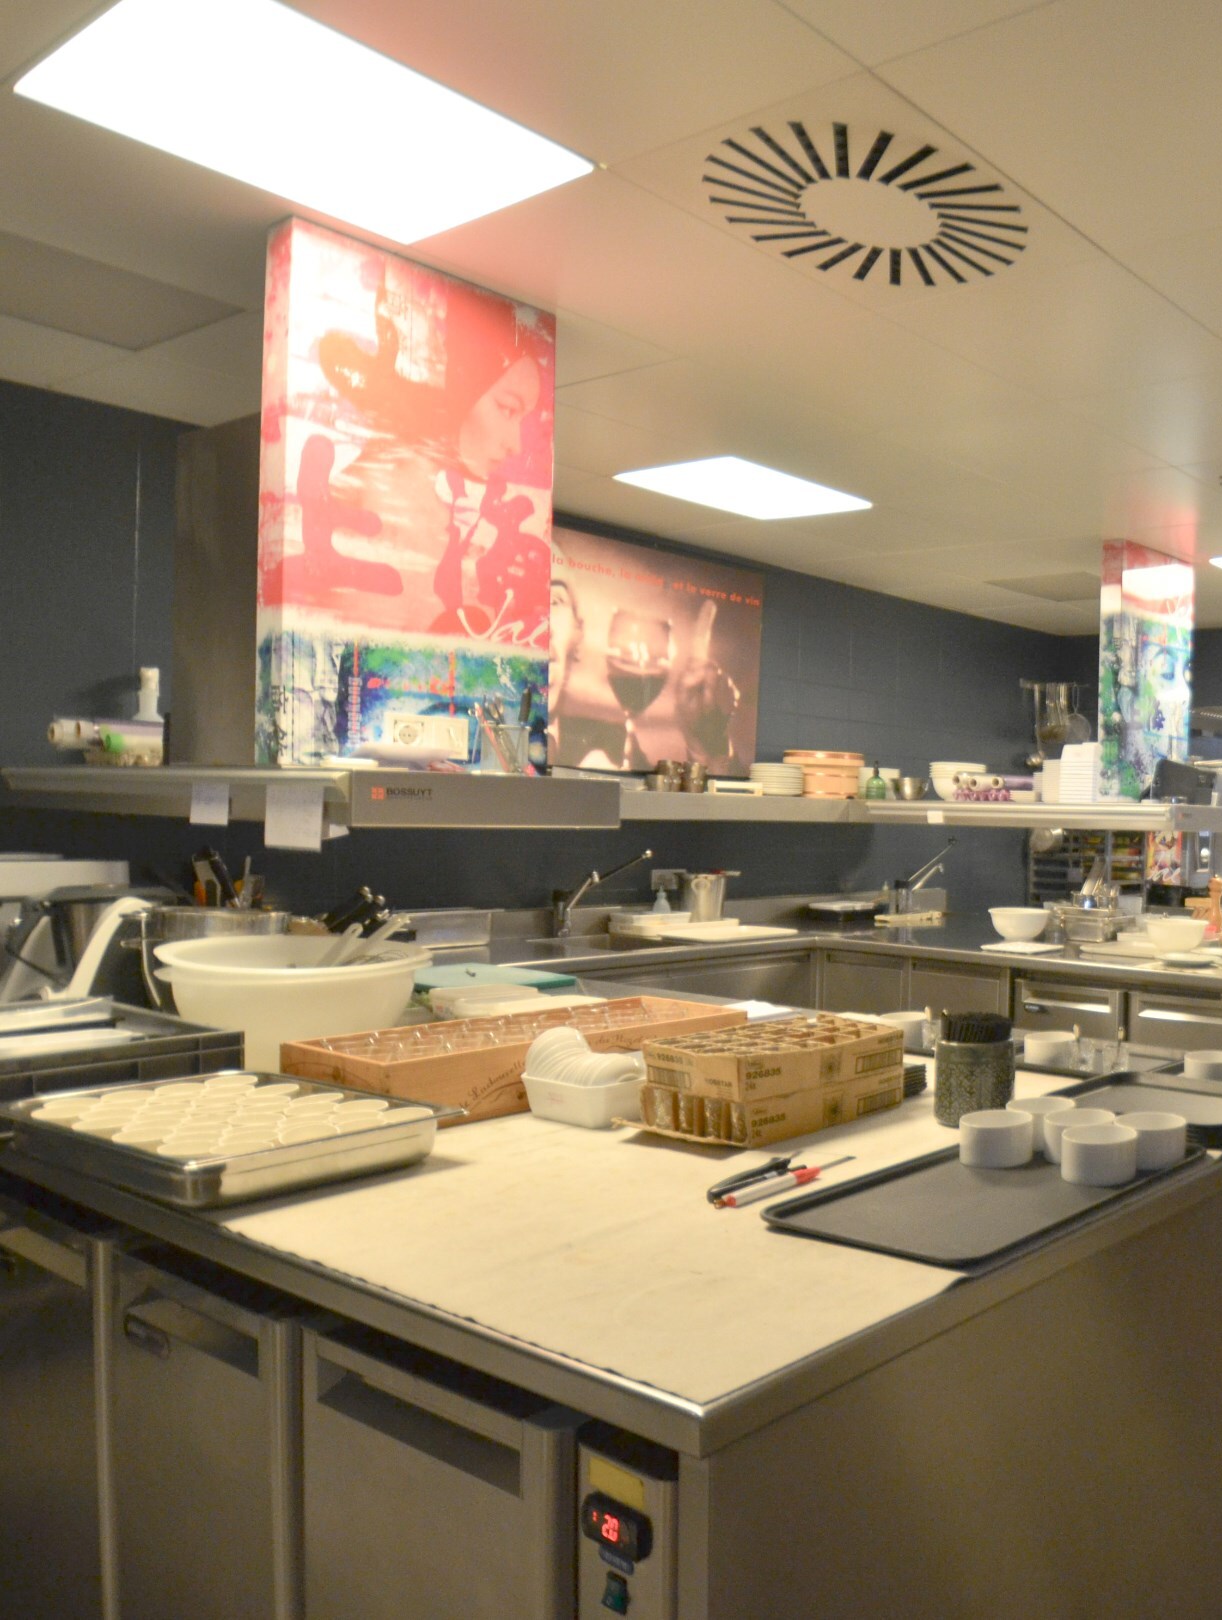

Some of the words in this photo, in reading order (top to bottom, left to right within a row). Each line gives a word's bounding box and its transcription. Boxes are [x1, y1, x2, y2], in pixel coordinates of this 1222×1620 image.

[701, 588, 727, 600] verre
[729, 593, 742, 604] de
[386, 787, 432, 796] BOSSUYT
[745, 1067, 781, 1080] 926835
